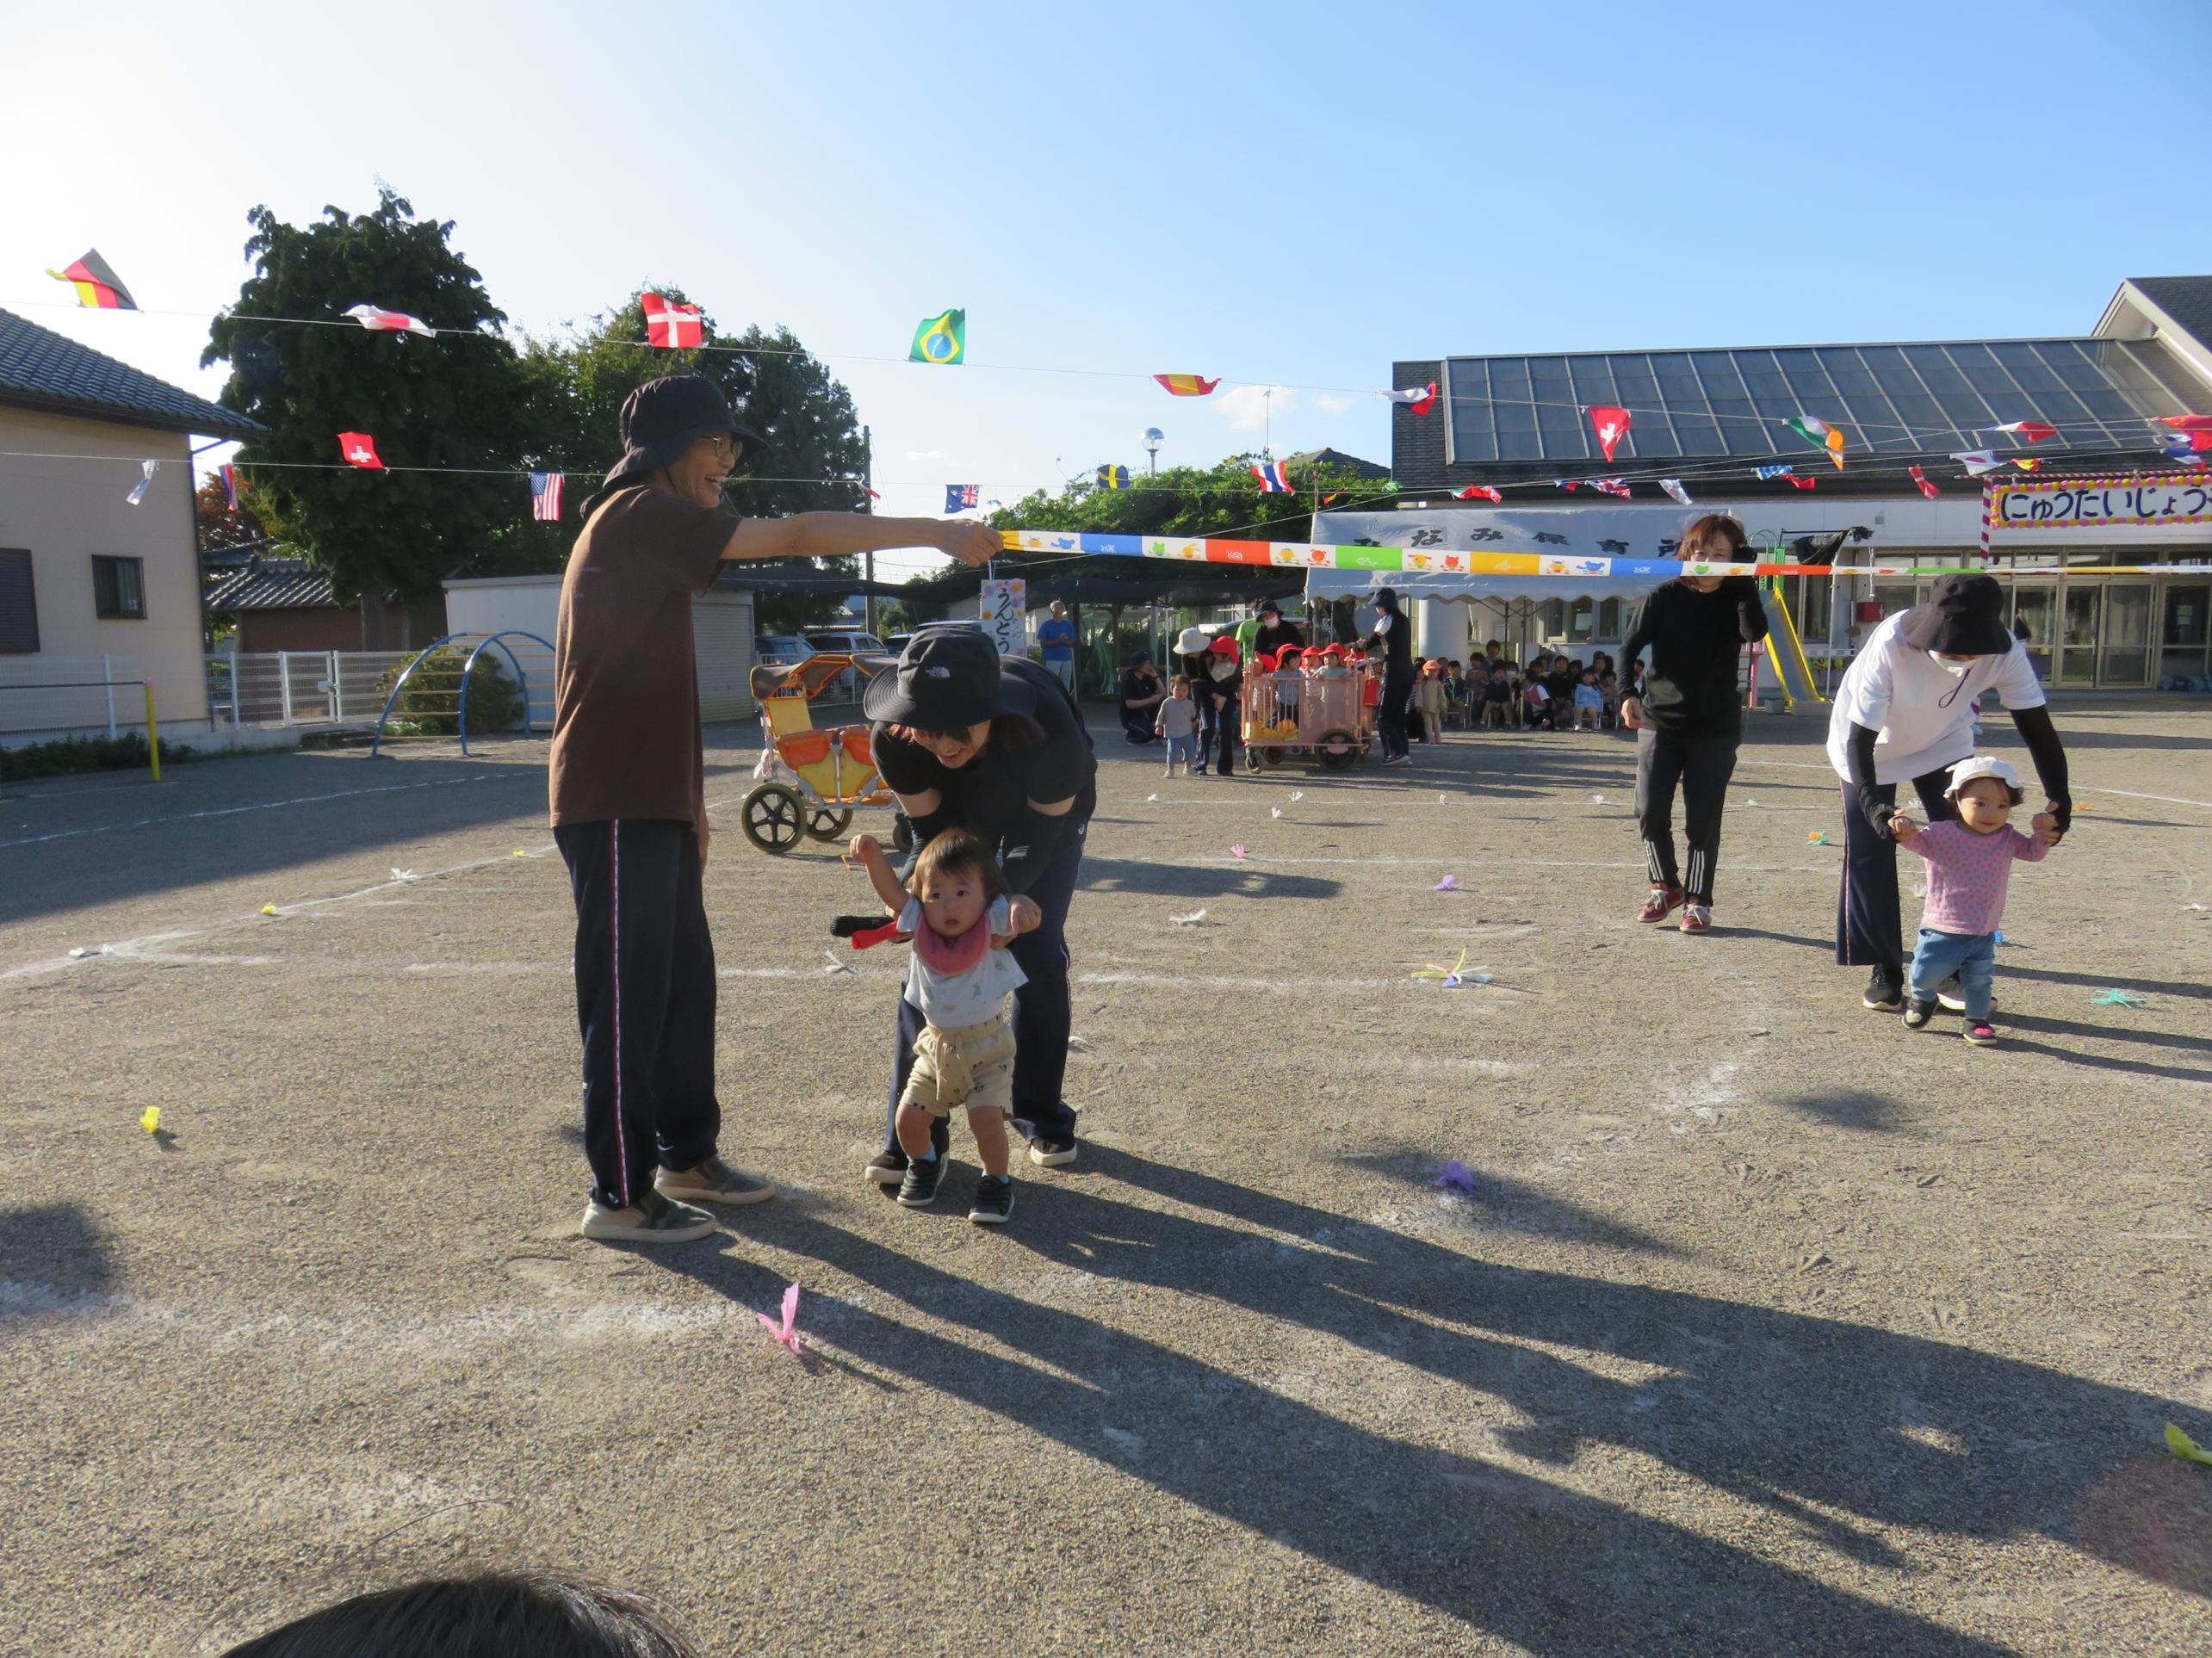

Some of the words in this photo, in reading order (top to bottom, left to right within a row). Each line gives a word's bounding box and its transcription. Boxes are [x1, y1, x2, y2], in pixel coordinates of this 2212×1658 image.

[2000, 484, 2212, 521] にゅうたいじょう
[994, 588, 1018, 654] うんどう
